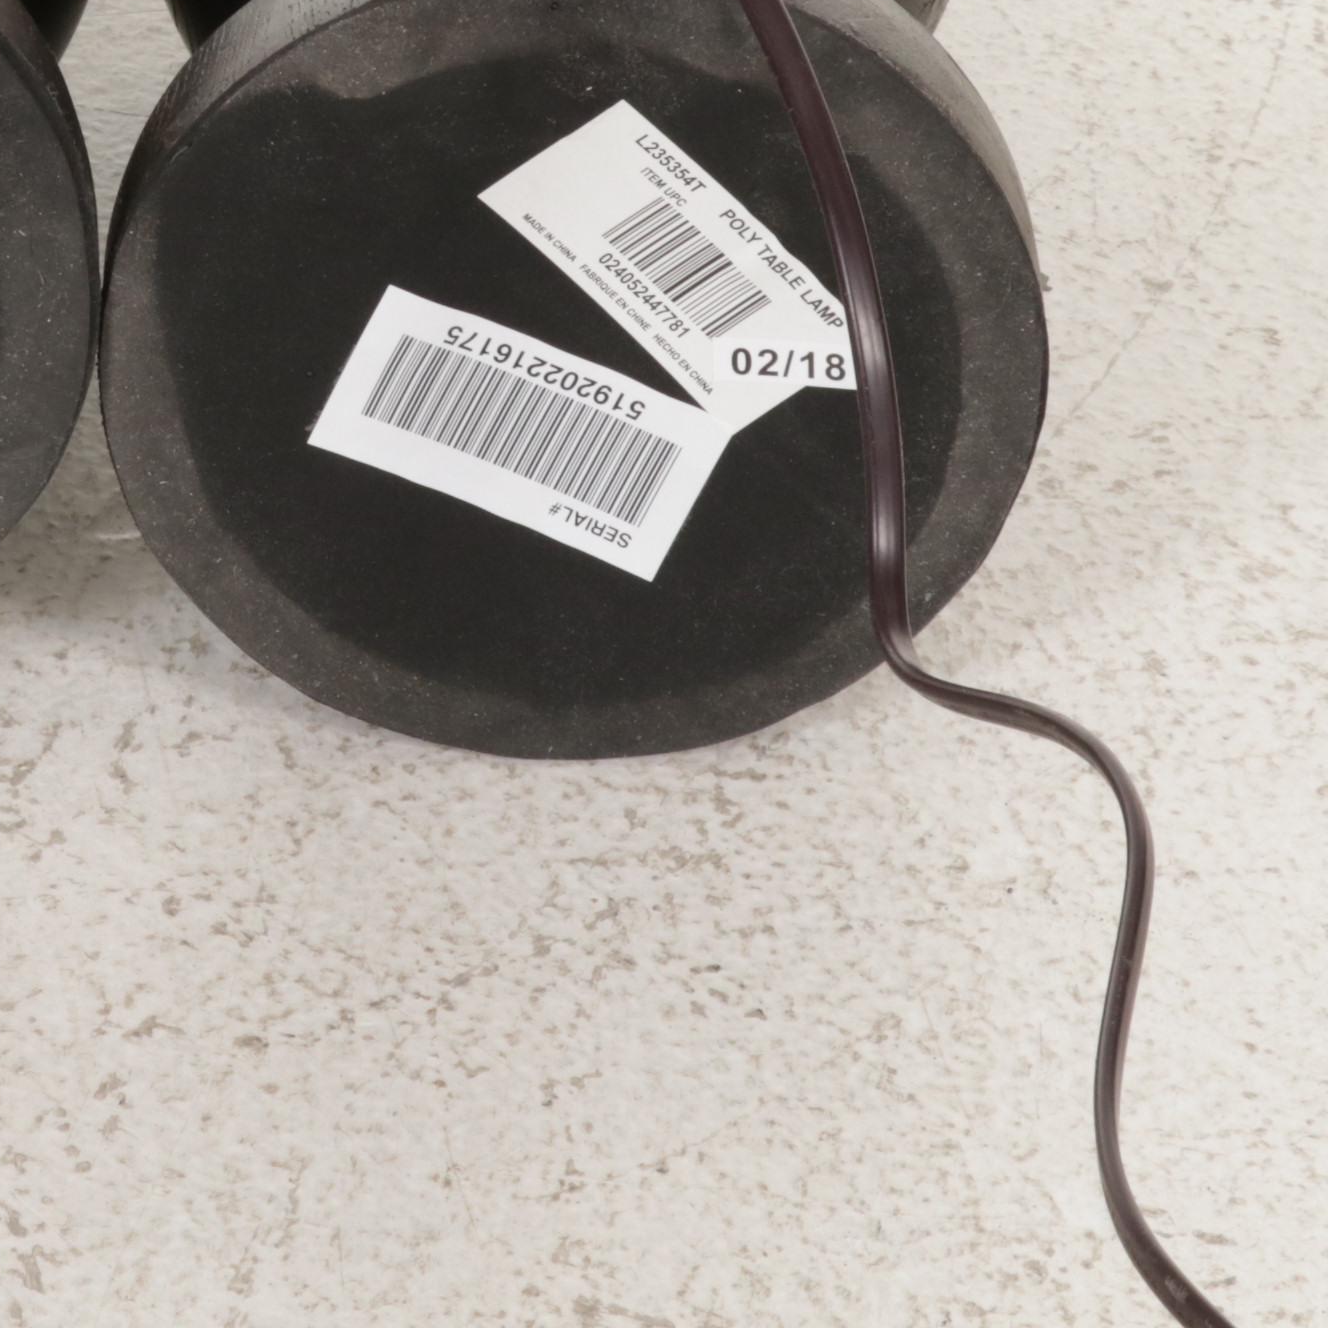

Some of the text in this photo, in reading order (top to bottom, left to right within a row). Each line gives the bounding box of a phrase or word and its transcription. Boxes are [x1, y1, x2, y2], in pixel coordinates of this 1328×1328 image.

[635, 134, 707, 192] L235354T
[640, 167, 688, 207] ITEM UPC
[522, 213, 713, 395] MADE IN CHINA FABRIQUE EN CHINE HECHO EN CHINA
[598, 252, 691, 339] 024052447781
[719, 208, 849, 328] POLY TABLE LAMP
[443, 325, 646, 421] 519202216175
[731, 347, 846, 382] 02/18
[548, 503, 632, 549] SERIAL#
